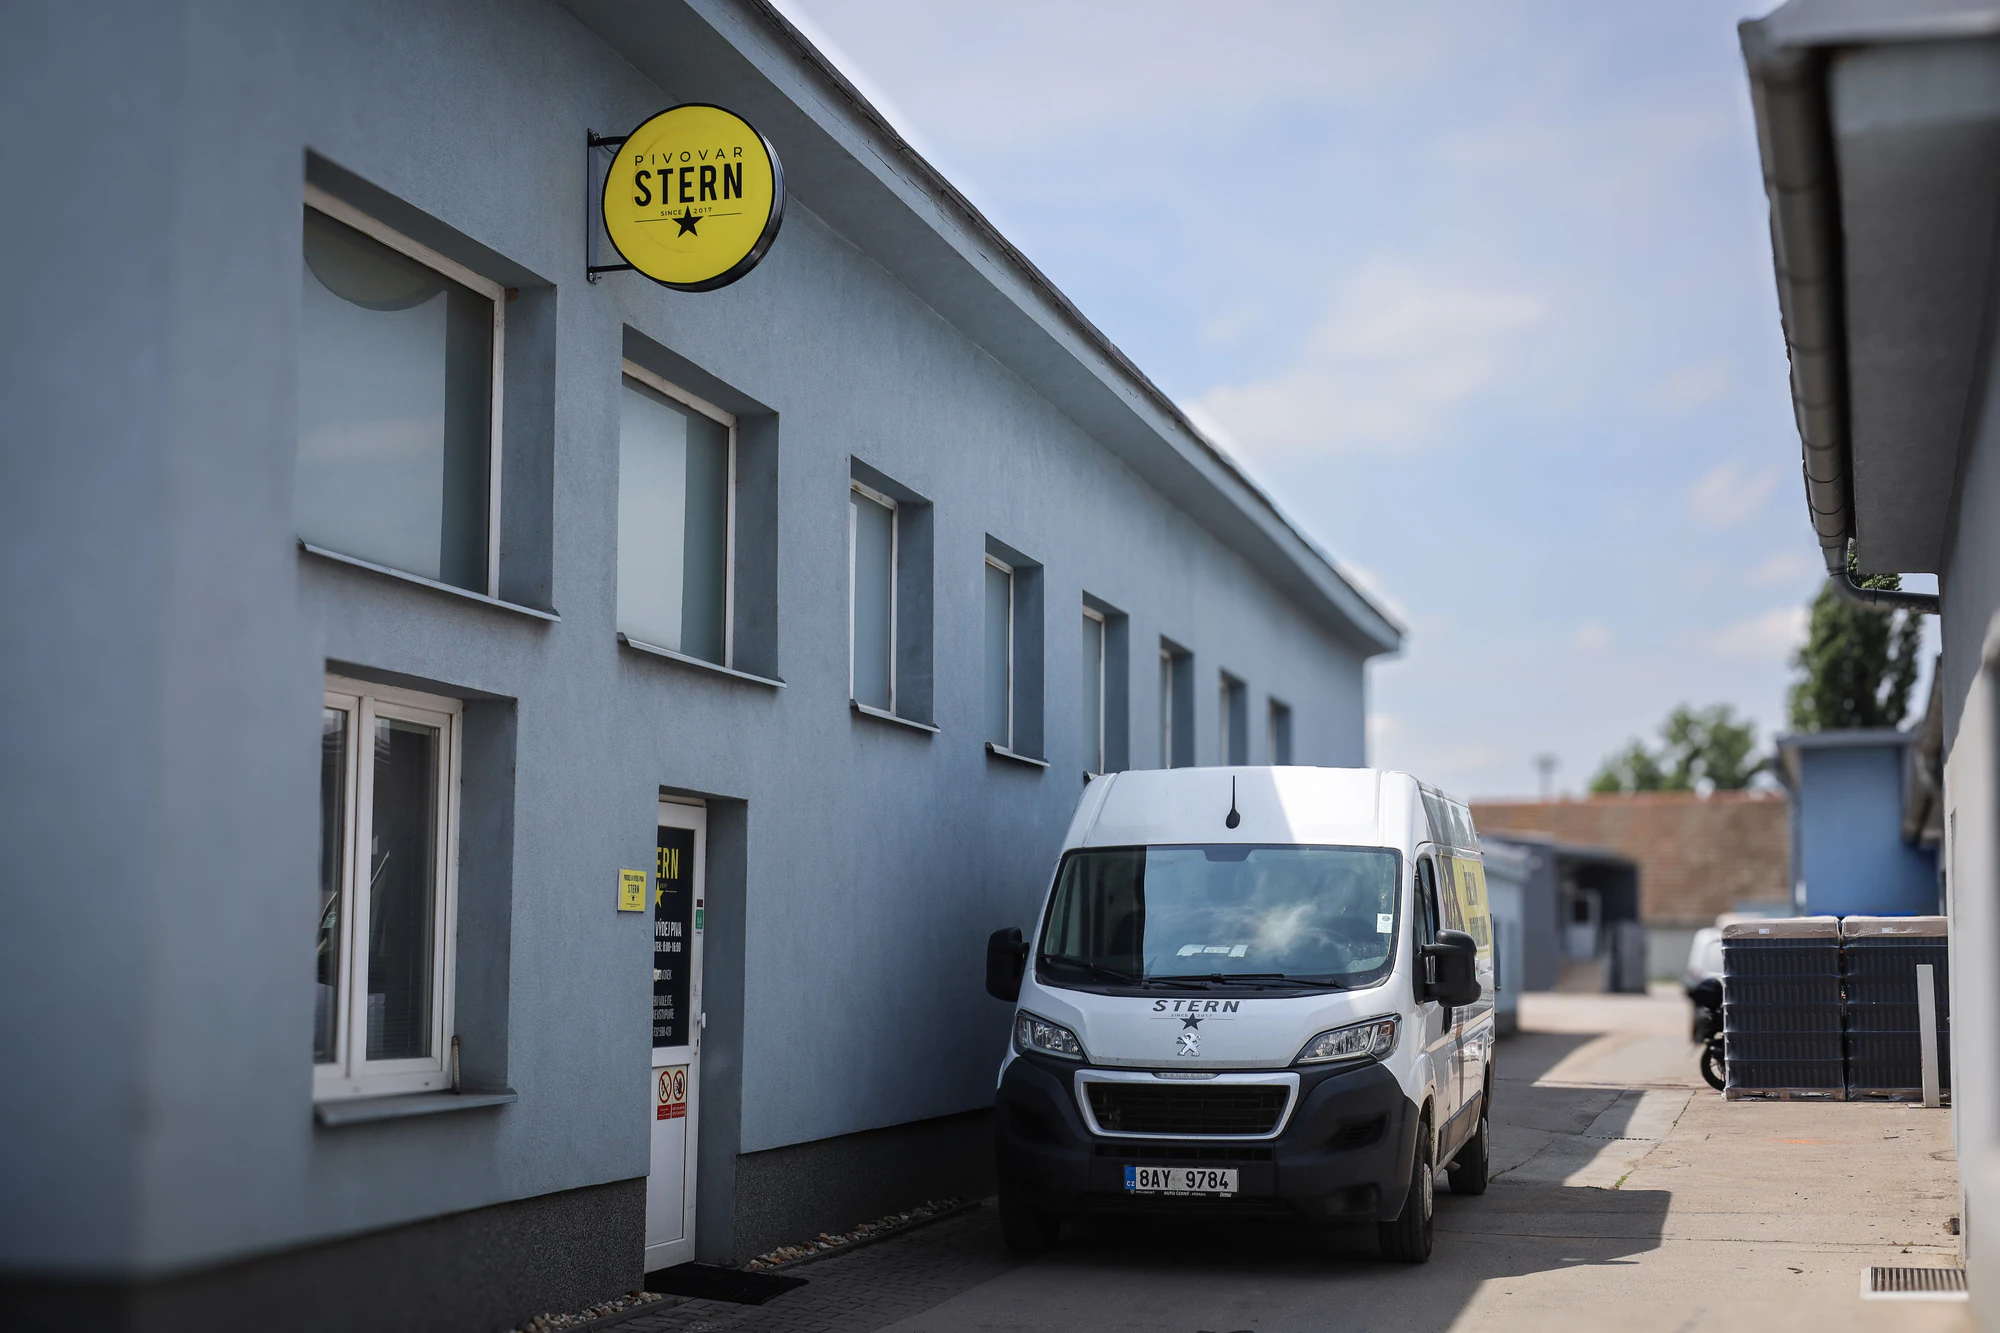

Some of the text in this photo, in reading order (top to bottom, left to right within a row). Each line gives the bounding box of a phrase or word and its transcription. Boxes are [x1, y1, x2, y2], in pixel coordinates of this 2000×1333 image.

[634, 147, 743, 166] PIVOVAR
[634, 162, 743, 207] STERN
[660, 209, 682, 217] SINCE
[628, 884, 640, 894] STERN
[655, 918, 682, 937] VÝDEJ PIVA
[1152, 1000, 1240, 1012] STERN
[1139, 1169, 1172, 1188] 8AY
[1185, 1170, 1229, 1190] 9784
